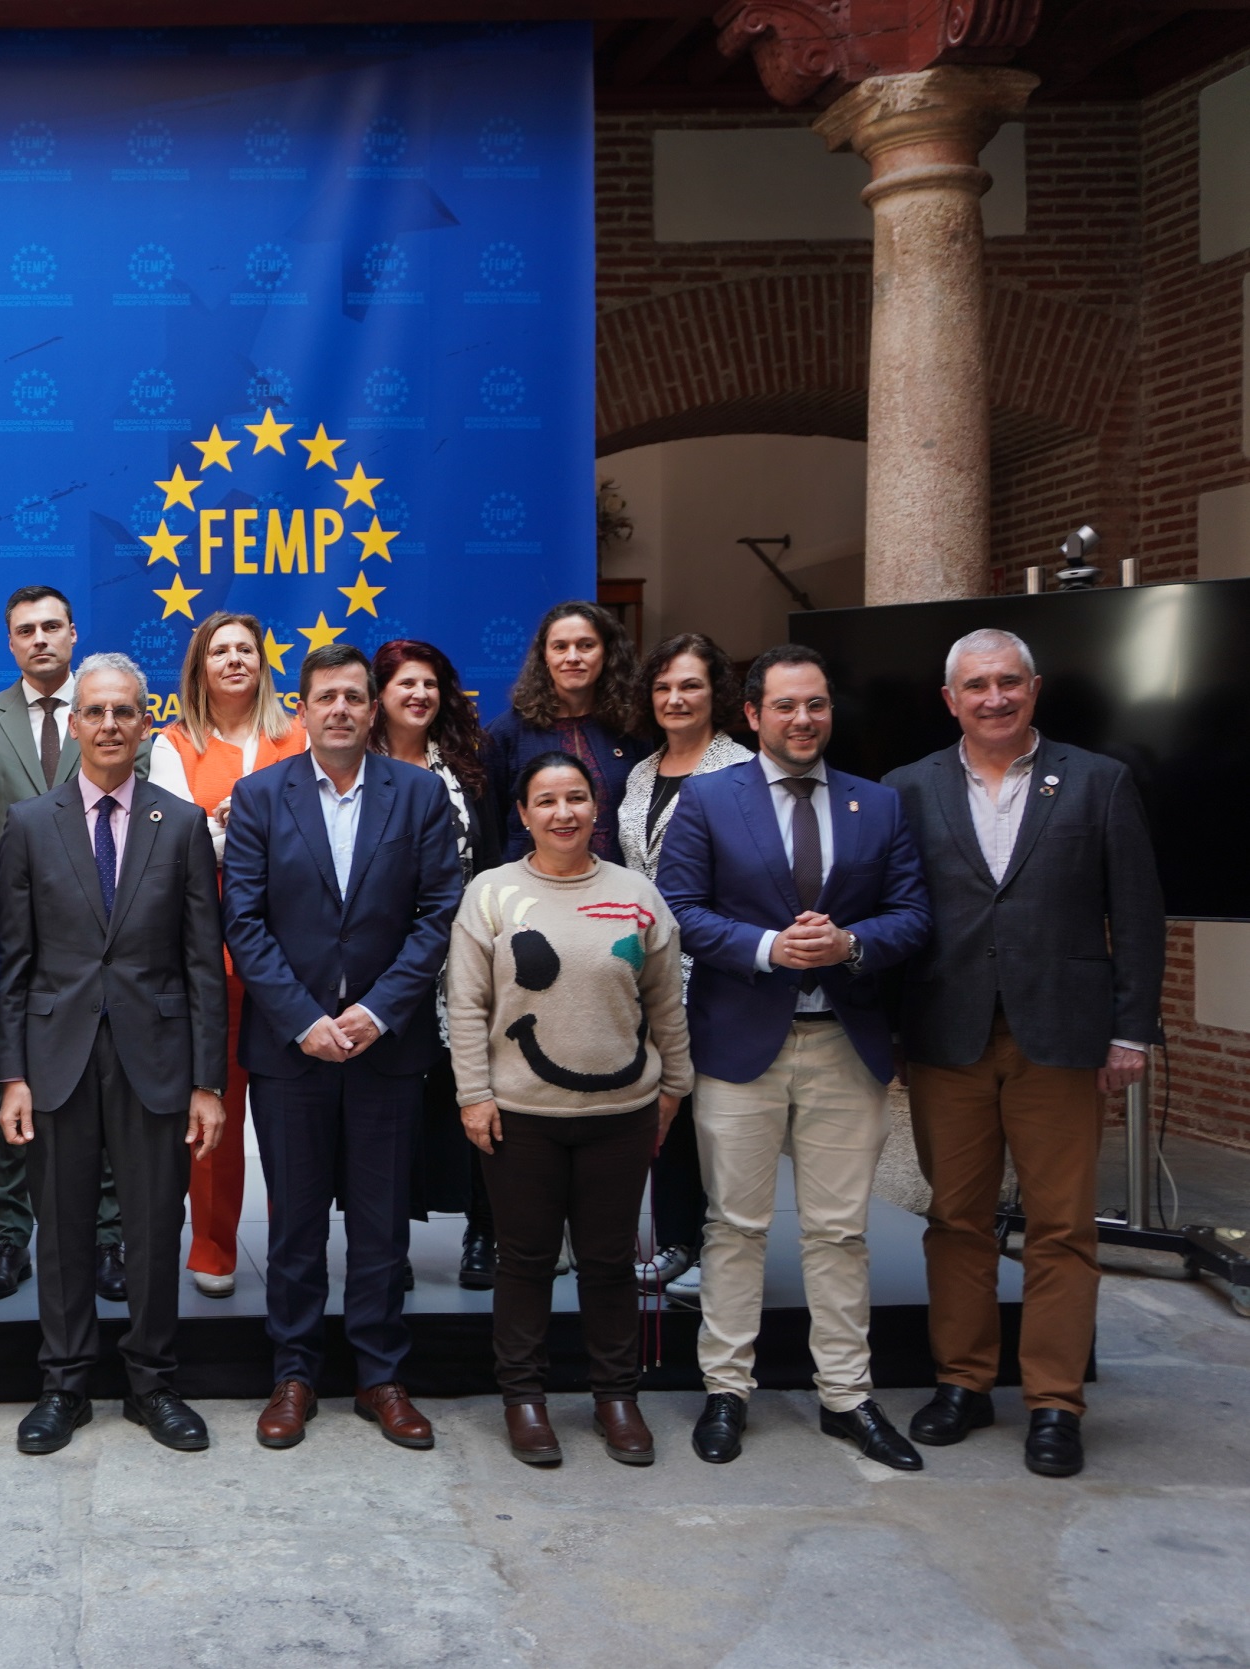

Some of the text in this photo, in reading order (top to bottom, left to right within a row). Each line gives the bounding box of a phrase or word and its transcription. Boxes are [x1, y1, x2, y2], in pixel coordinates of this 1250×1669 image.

[20, 261, 48, 274] FEMP
[138, 260, 166, 273] FEMP
[255, 259, 283, 272] FEMP
[372, 259, 400, 272] FEMP
[488, 258, 516, 271] FEMP
[21, 386, 49, 399] FEMP
[139, 385, 167, 398] FEMP
[255, 384, 283, 397] FEMP
[372, 383, 400, 396] FEMP
[489, 383, 517, 396] FEMP
[22, 511, 50, 524] FEMP
[490, 508, 518, 521] FEMP
[199, 508, 344, 575] FEMP
[140, 636, 168, 649] FEMP
[490, 633, 518, 646] FEMP
